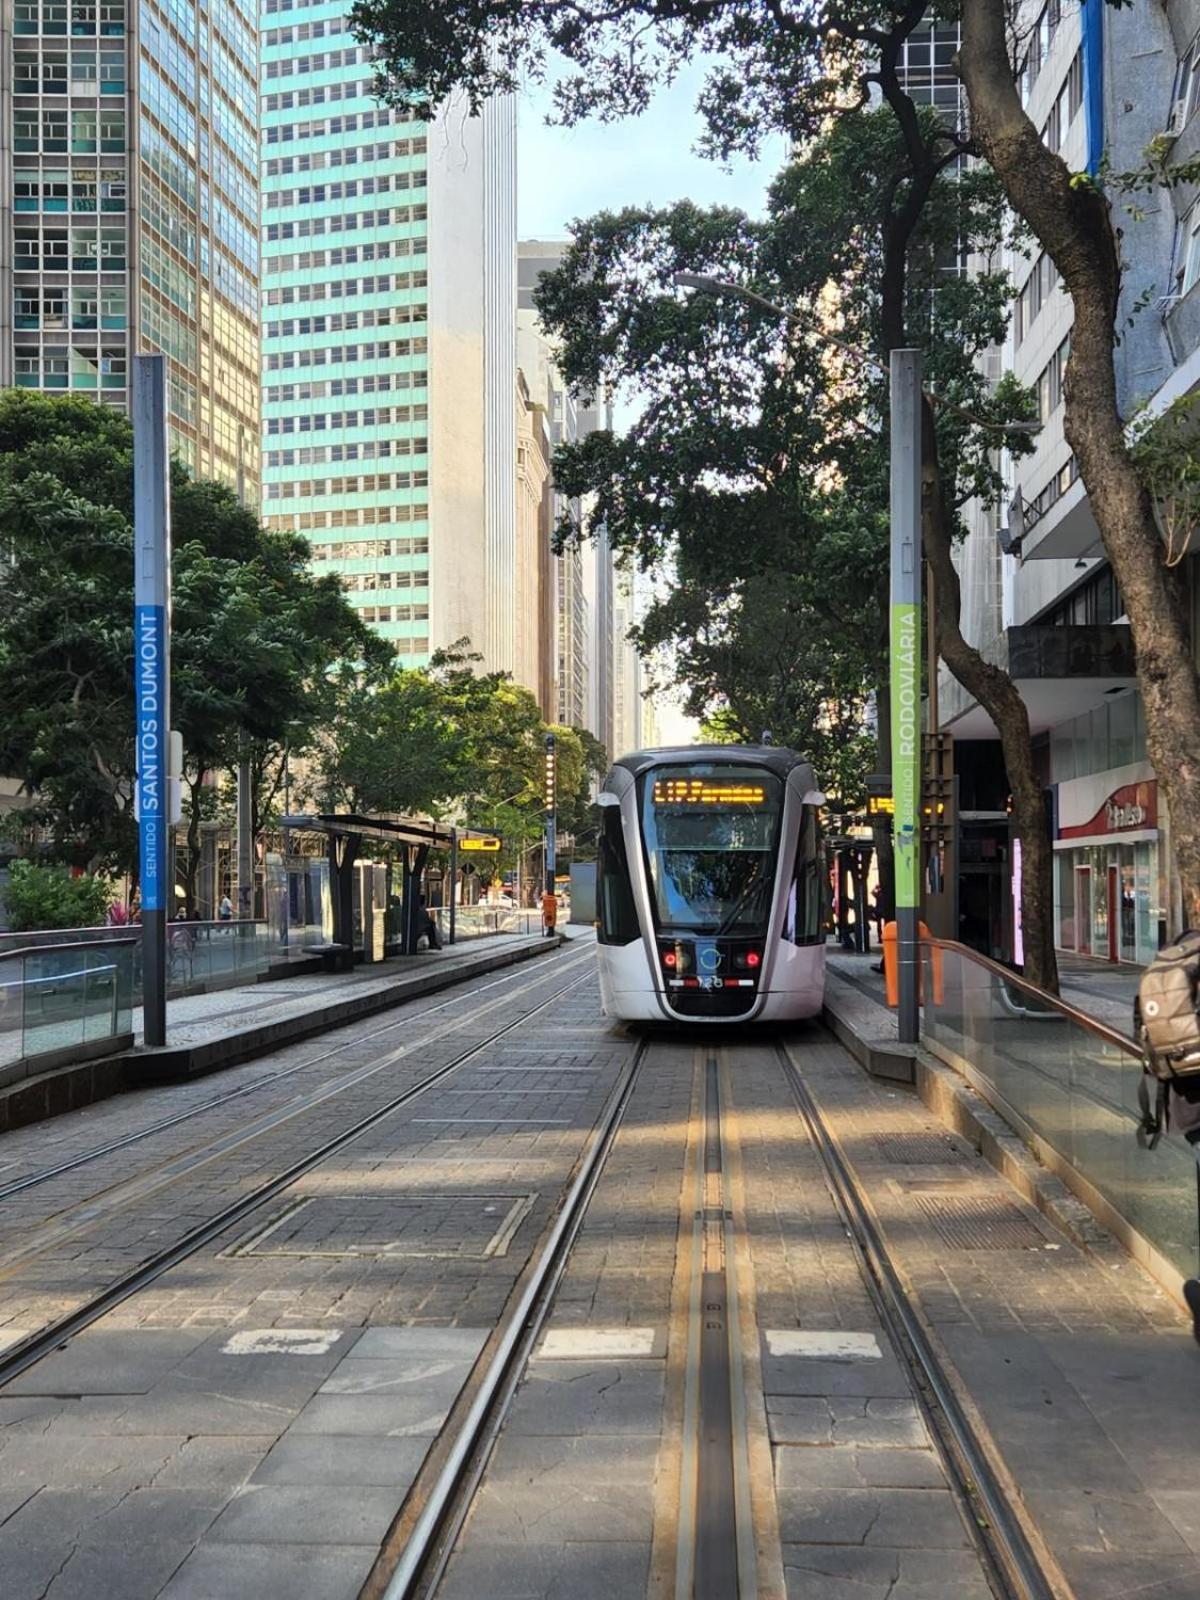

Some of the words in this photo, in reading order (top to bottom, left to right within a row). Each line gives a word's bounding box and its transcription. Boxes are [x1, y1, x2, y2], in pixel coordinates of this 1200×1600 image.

[141, 612, 157, 711] DUMONT
[896, 611, 915, 756] RODOVIÁRIA
[142, 719, 158, 810] SANTOS
[903, 768, 914, 825] SENTIDO
[145, 822, 157, 878] SENTIDO
